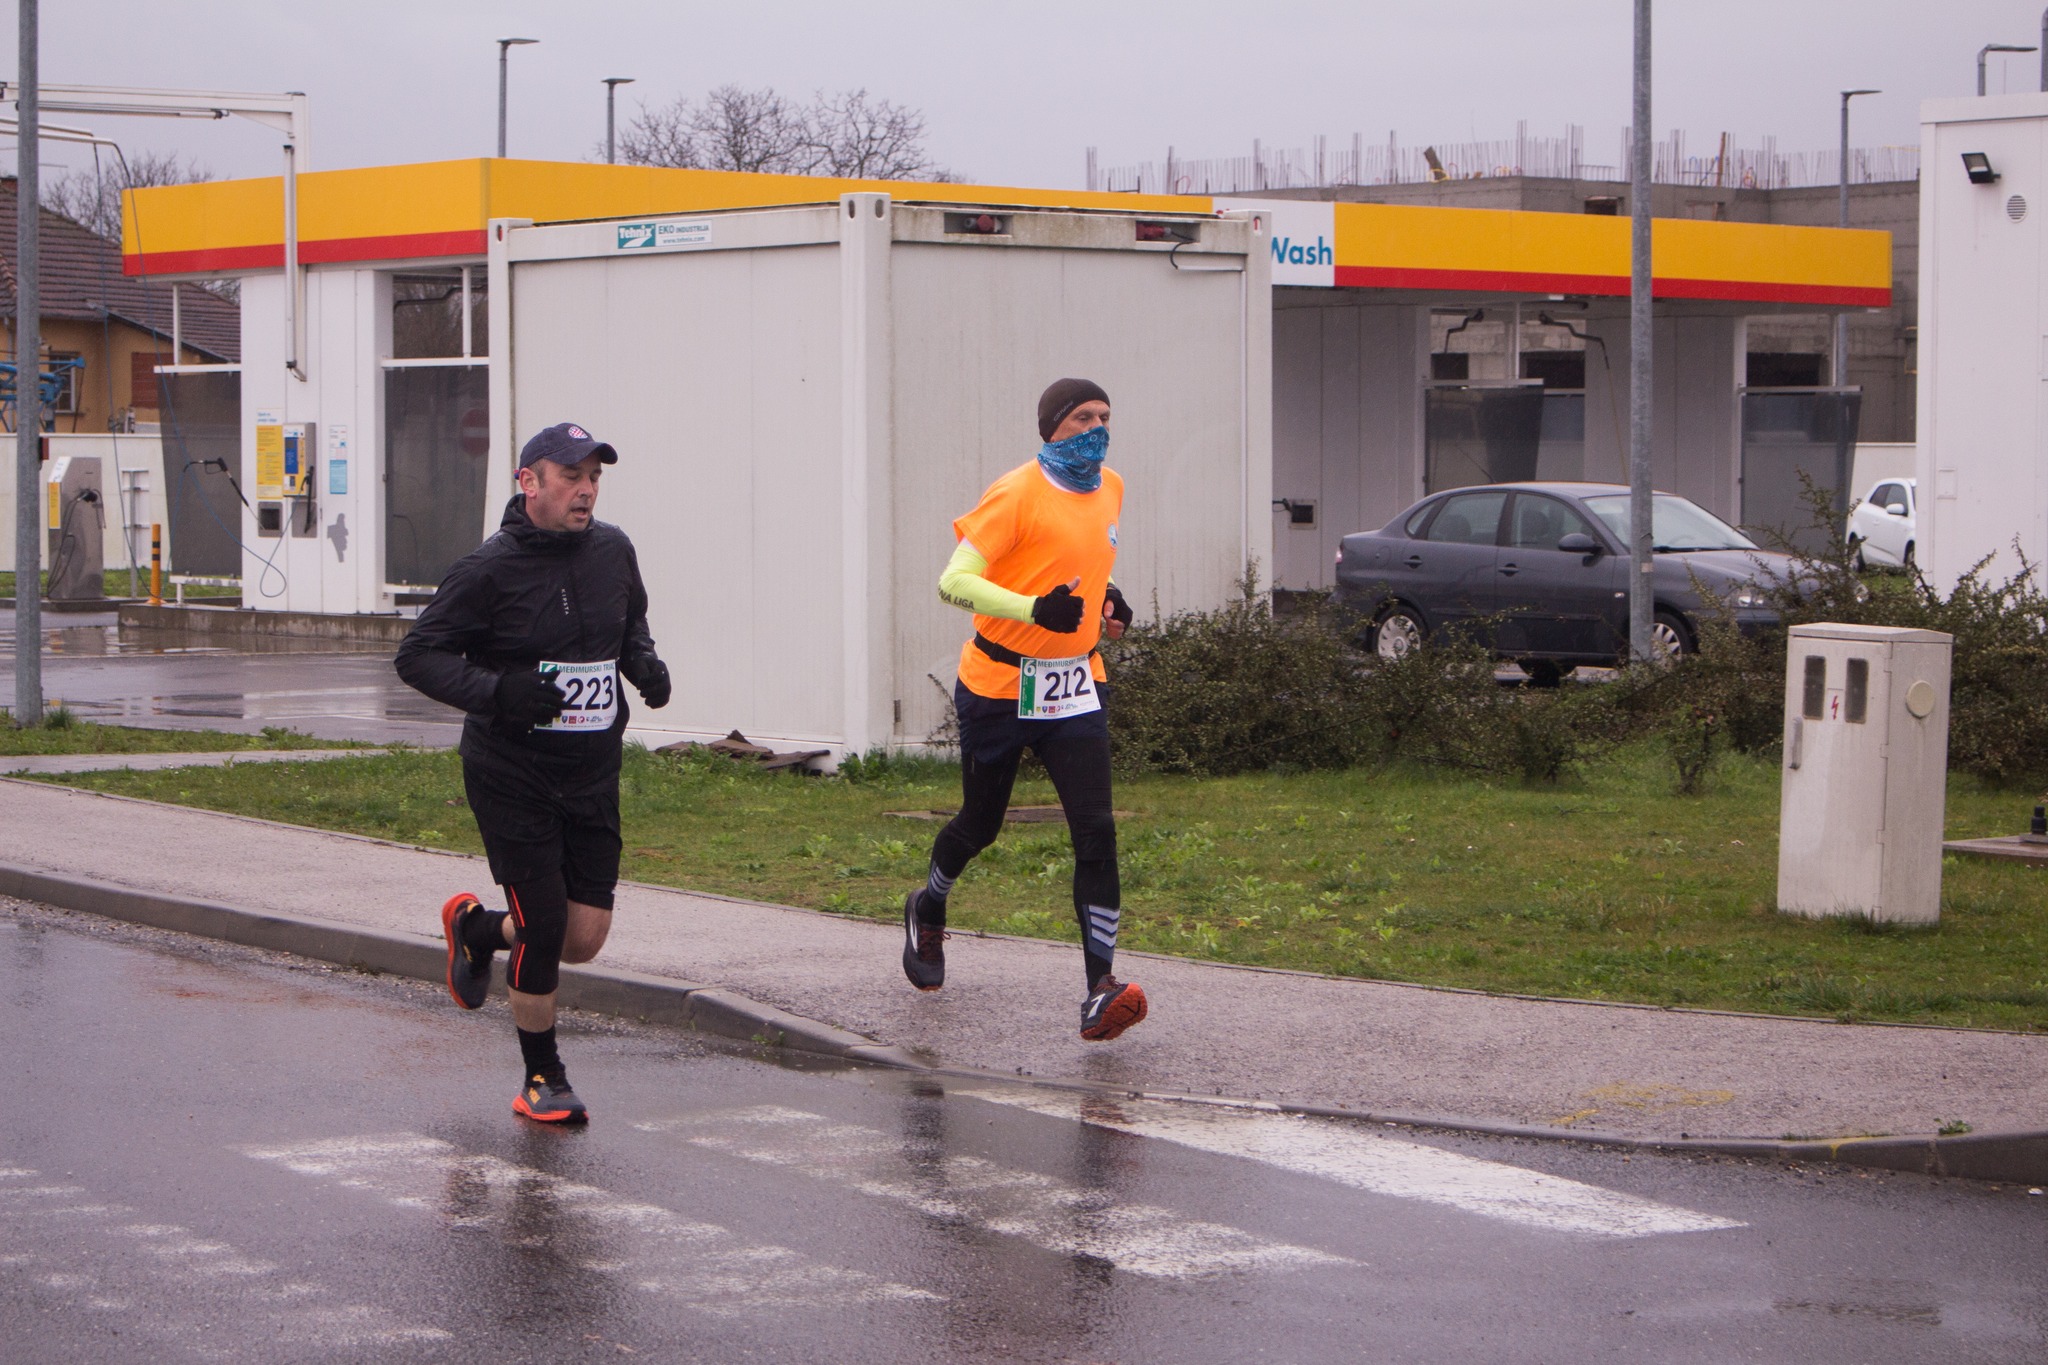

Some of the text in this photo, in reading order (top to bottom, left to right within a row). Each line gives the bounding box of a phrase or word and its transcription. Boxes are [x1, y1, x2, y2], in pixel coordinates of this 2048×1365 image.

[619, 225, 653, 239] Tehnix
[658, 225, 709, 235] EKO INDUSTRIJA
[561, 588, 569, 615] KIPSTA
[953, 596, 975, 610] LIGA
[563, 675, 613, 710] 223
[1044, 666, 1091, 701] 212
